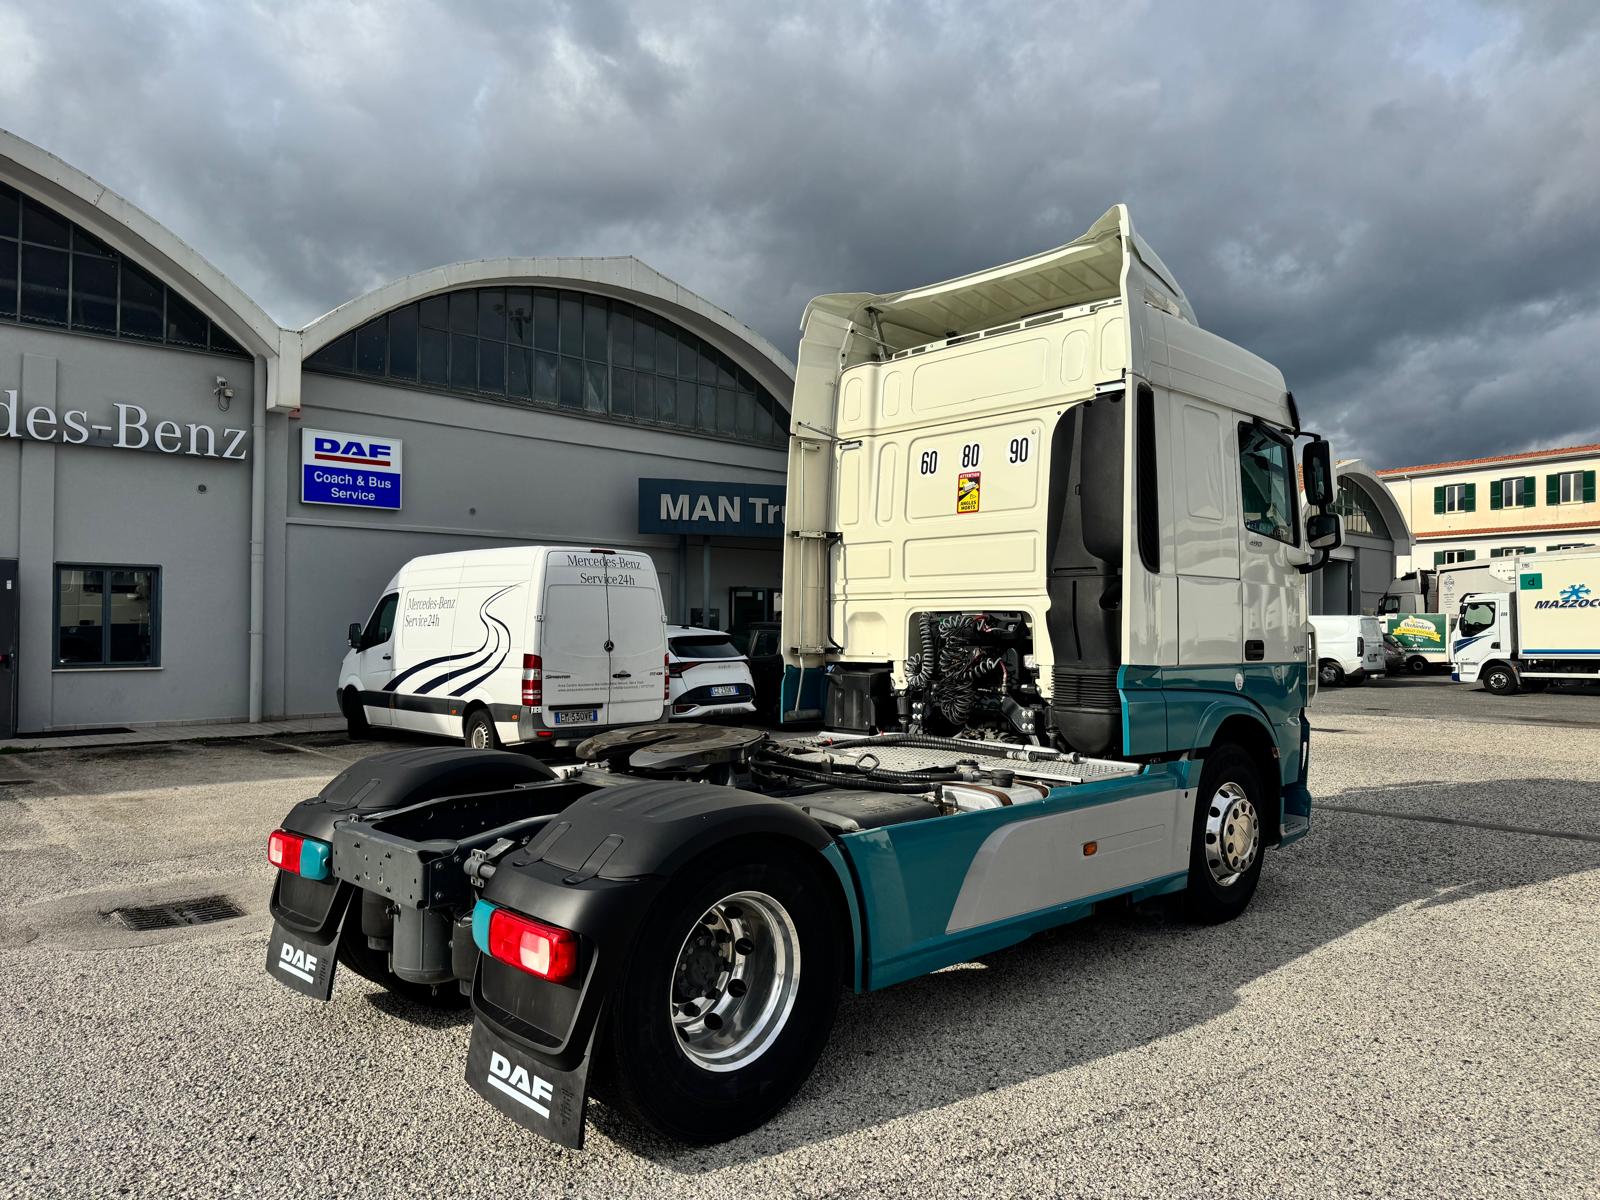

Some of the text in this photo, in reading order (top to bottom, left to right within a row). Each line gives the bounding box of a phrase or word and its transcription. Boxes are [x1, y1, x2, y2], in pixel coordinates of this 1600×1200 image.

[314, 437, 391, 458] DAF
[921, 437, 1029, 475] 60 80 90
[313, 471, 392, 488] Coach & Bus
[331, 487, 376, 501] Service
[660, 493, 787, 525] MAN Tr
[567, 554, 641, 570] Mercedes-Benz
[407, 597, 457, 611] Mercedes-Benz
[1534, 598, 1600, 609] MAZZOC
[280, 942, 318, 972] DAF
[489, 1050, 554, 1101] DAF
